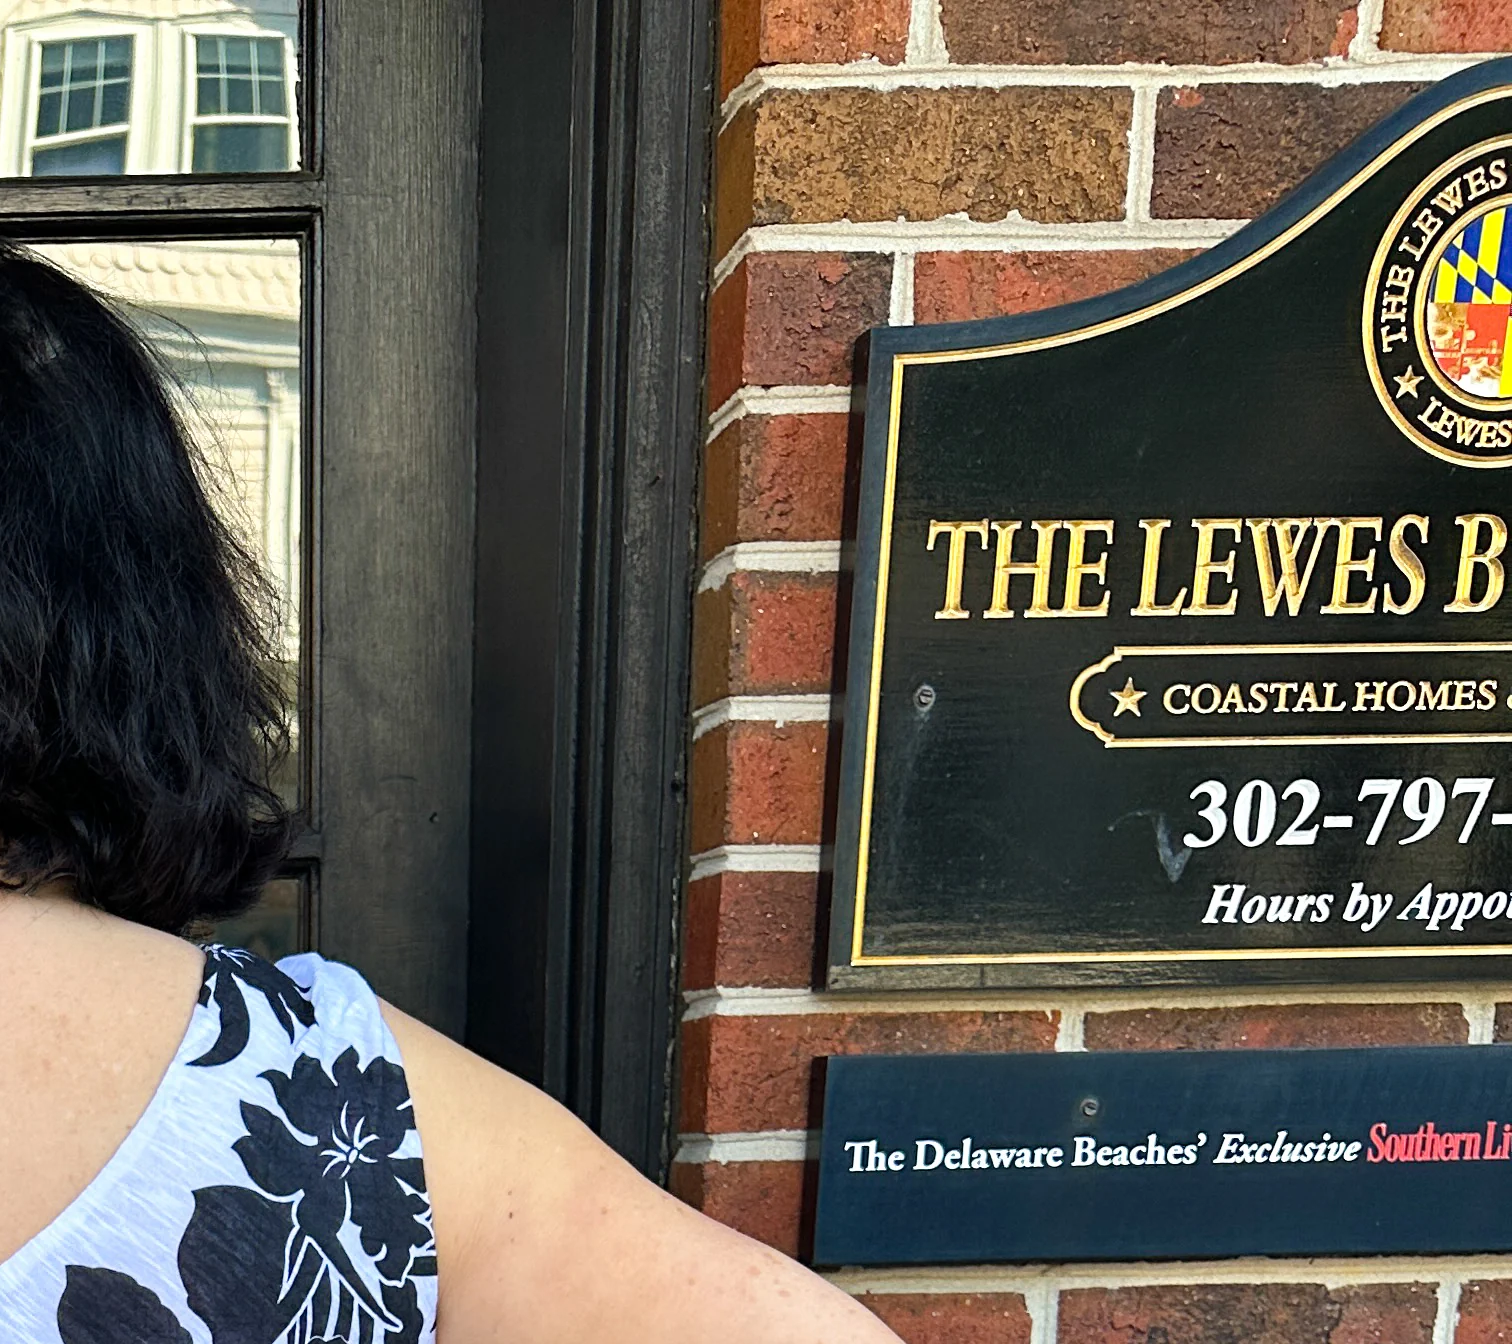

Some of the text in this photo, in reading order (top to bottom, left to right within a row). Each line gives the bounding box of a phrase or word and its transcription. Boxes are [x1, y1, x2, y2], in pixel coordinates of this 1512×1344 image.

[1381, 158, 1508, 353] THE LEWES
[926, 517, 1114, 620] THE
[1130, 514, 1430, 617] LEWES
[1162, 679, 1498, 714] COASTAL HOMES
[1201, 885, 1332, 924] Hours
[1343, 882, 1394, 932] by
[844, 1140, 905, 1172] The
[912, 1136, 1063, 1171] Delaware
[1213, 1130, 1362, 1164] Exclusive
[1366, 1121, 1481, 1163] Southern
[1483, 1120, 1512, 1160] Li
